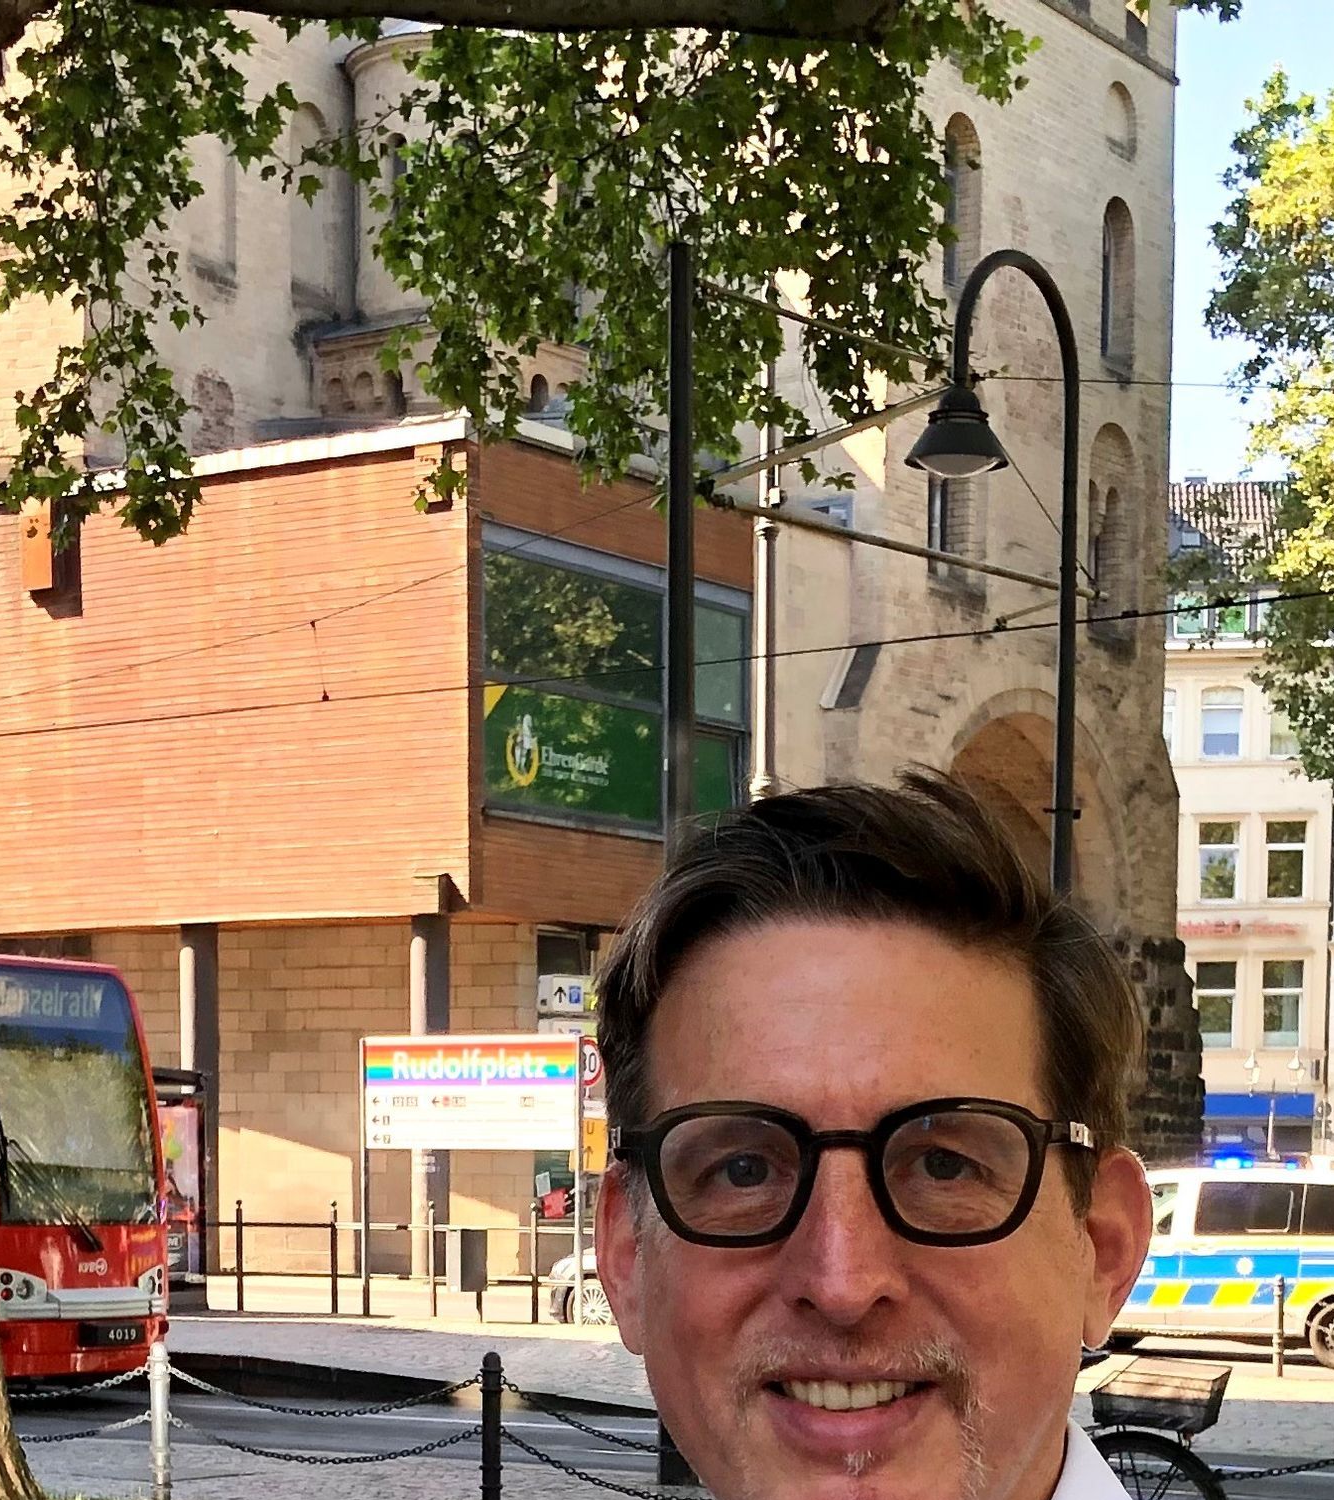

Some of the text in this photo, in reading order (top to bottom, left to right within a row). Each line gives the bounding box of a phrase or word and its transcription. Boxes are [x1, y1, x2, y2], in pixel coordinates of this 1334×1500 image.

[392, 1048, 548, 1086] Rudolfplatz
[586, 1122, 595, 1134] U
[109, 1328, 137, 1340] 4019
